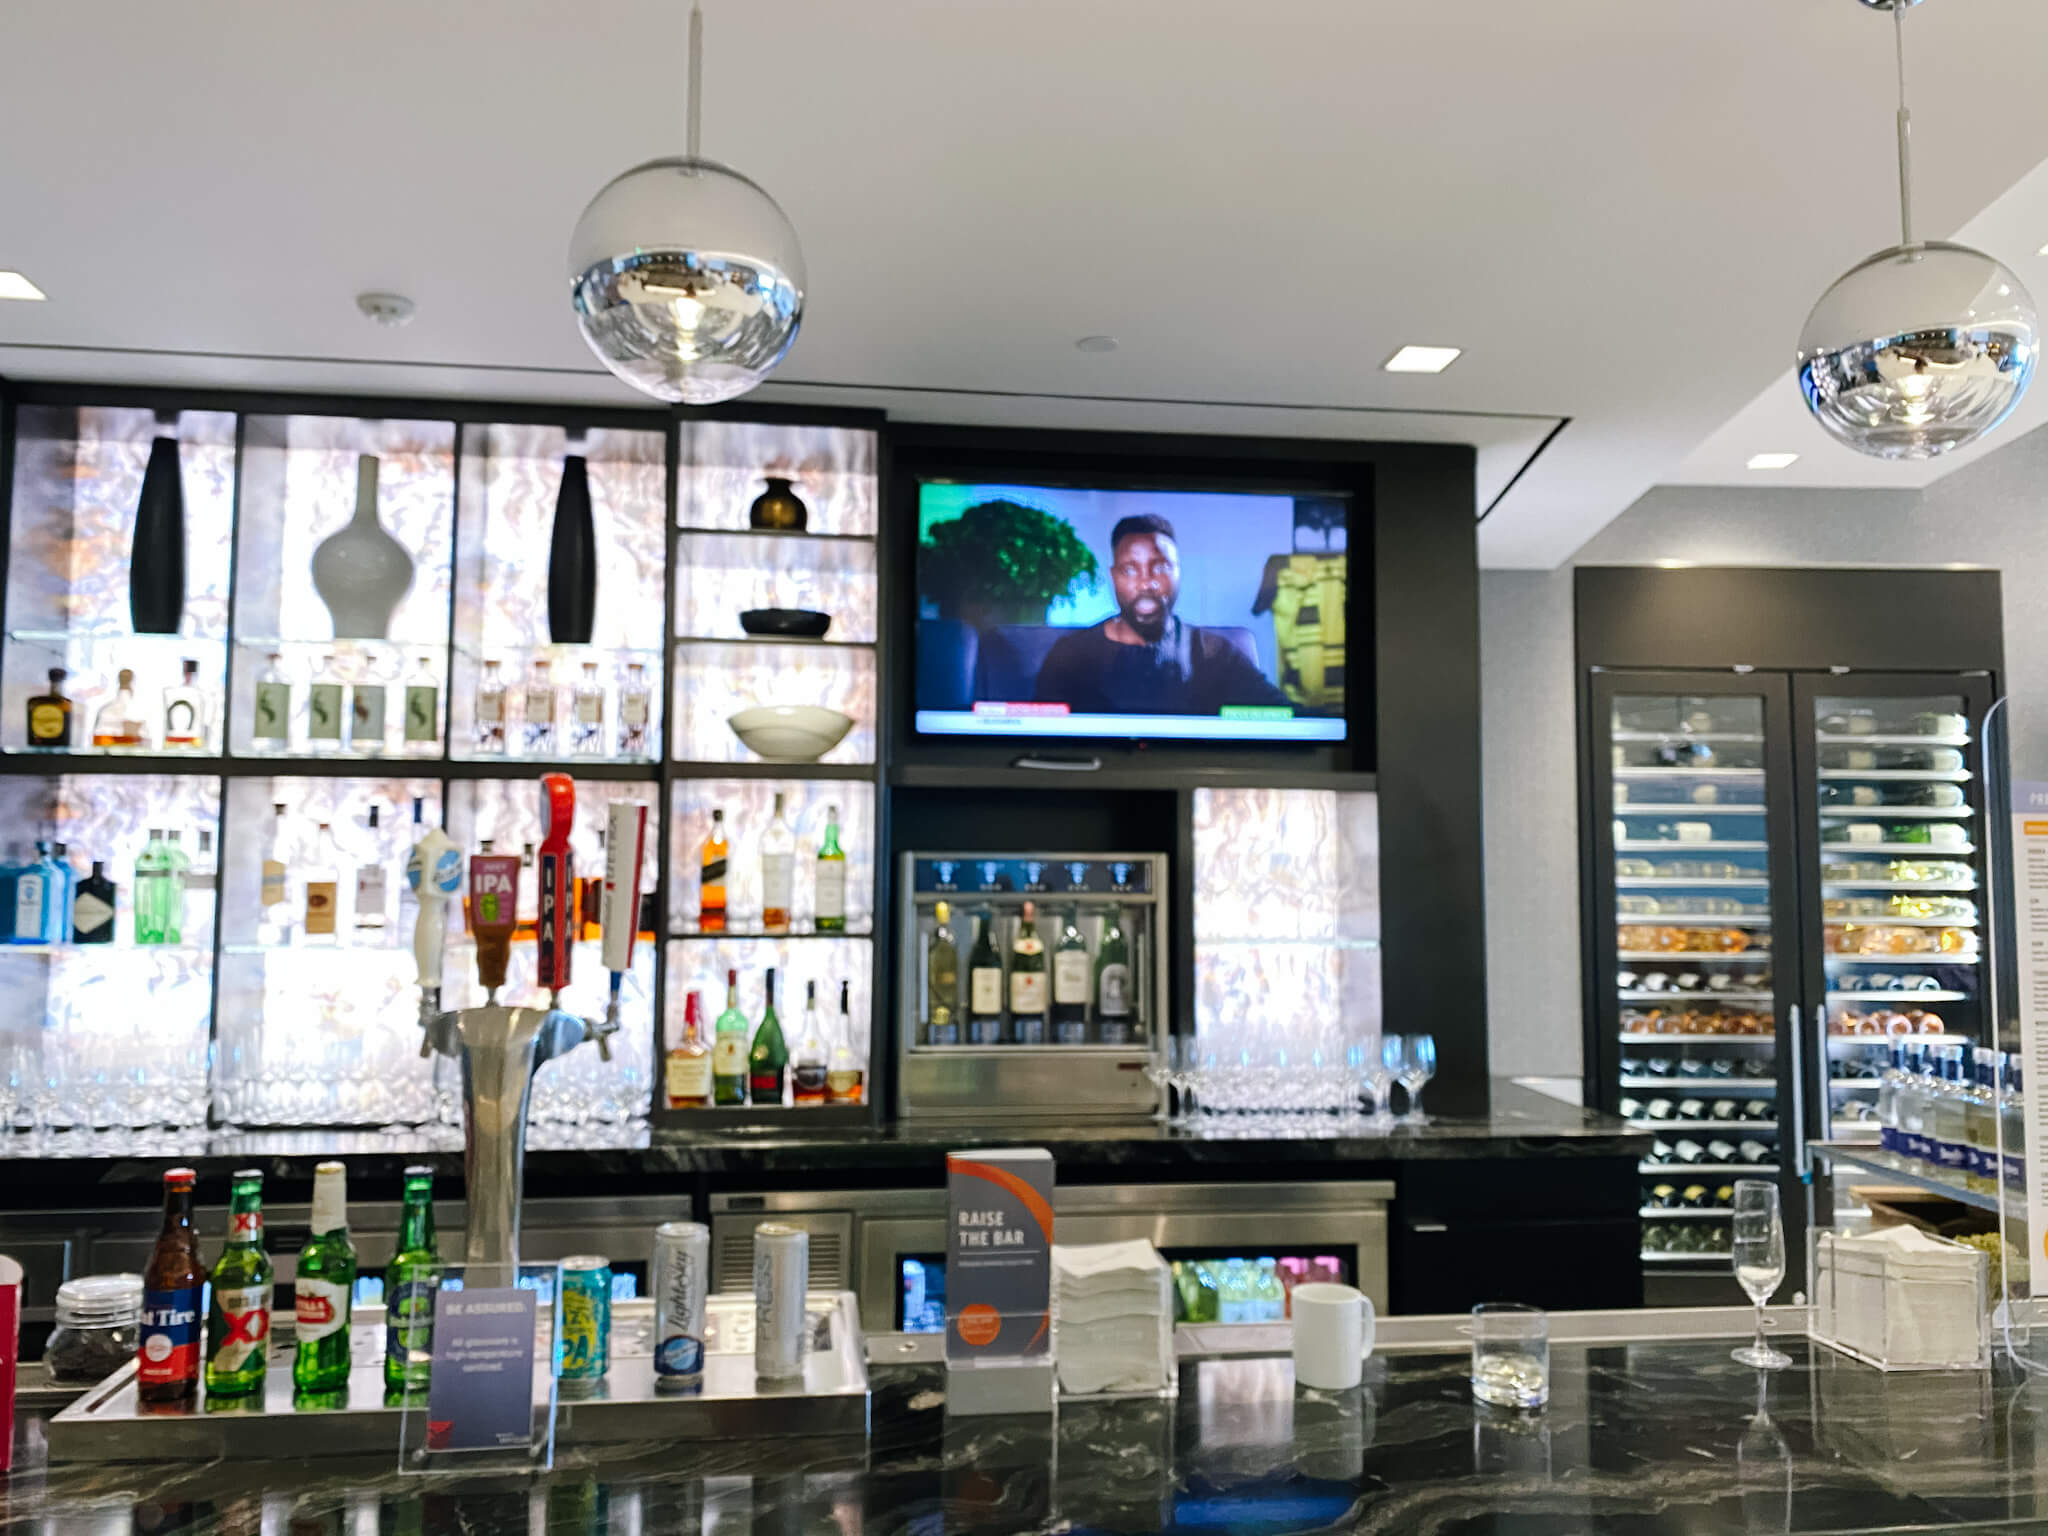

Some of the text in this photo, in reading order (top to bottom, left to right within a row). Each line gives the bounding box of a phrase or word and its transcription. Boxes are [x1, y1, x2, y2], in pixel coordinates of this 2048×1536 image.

[475, 873, 512, 893] IPA
[542, 867, 555, 942] IPA
[958, 1210, 1005, 1227] RAISE
[958, 1229, 1025, 1247] THE BAR
[156, 1308, 195, 1327] Tire
[561, 1335, 590, 1365] PA
